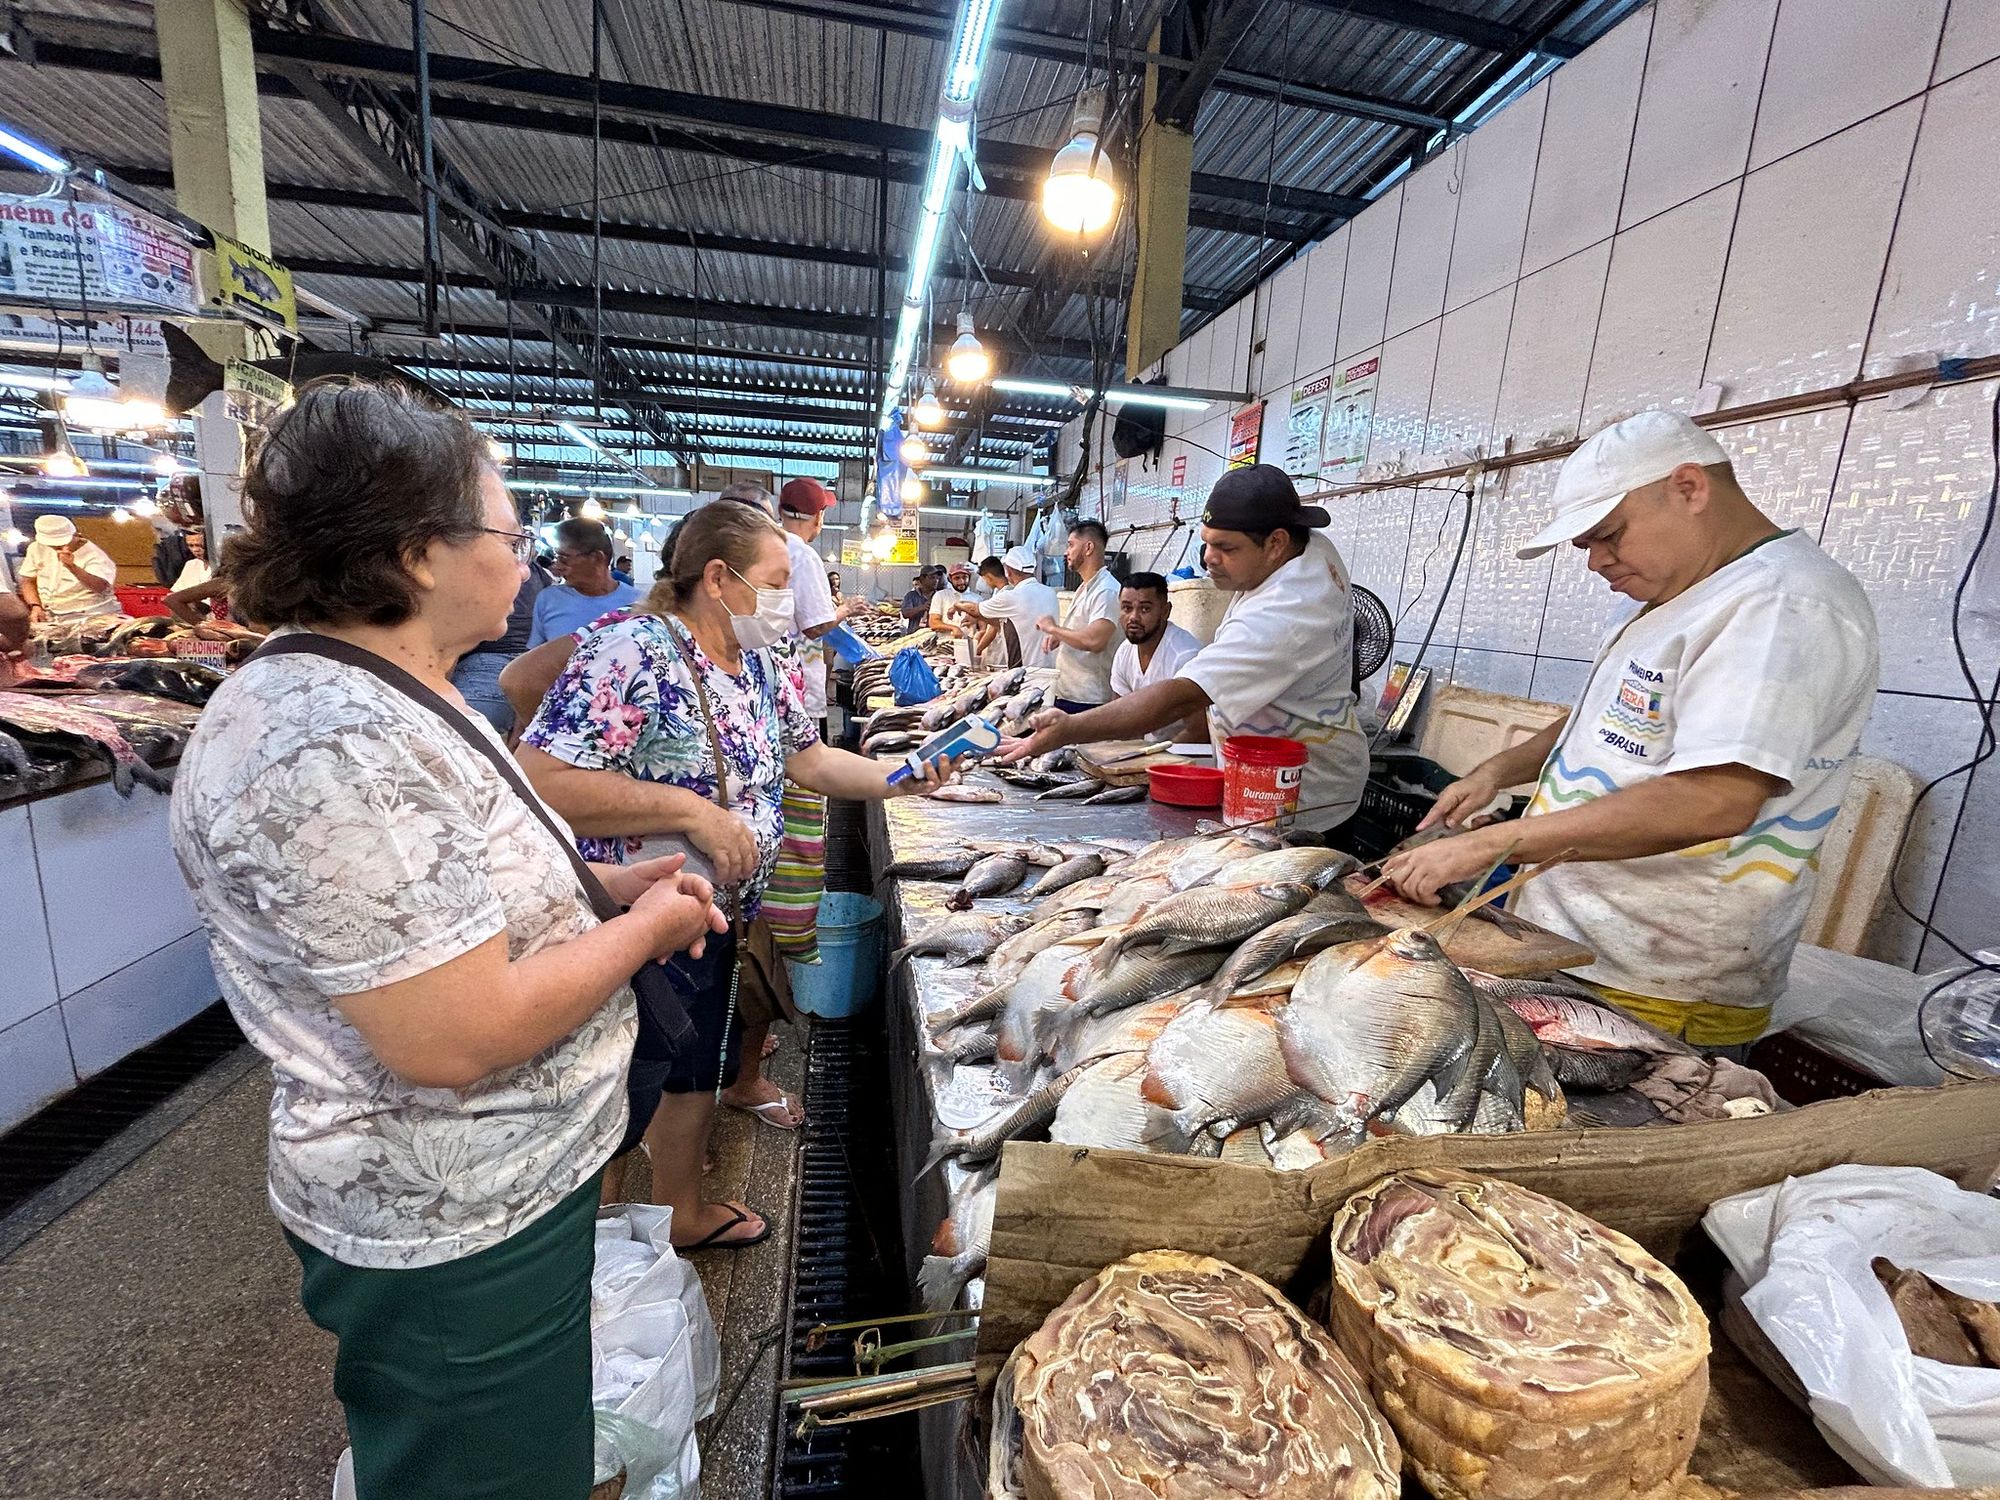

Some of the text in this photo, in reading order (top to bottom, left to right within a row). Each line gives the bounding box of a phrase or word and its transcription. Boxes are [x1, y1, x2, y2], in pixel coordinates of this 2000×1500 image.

[128, 338, 164, 347] ESCADO-
[1303, 378, 1329, 396] DEFESO
[178, 641, 225, 655] PICADINHO
[1628, 660, 1665, 683] PRIMEIRA
[1598, 728, 1648, 758] DO BRASIL
[1243, 787, 1286, 801] Duramais
